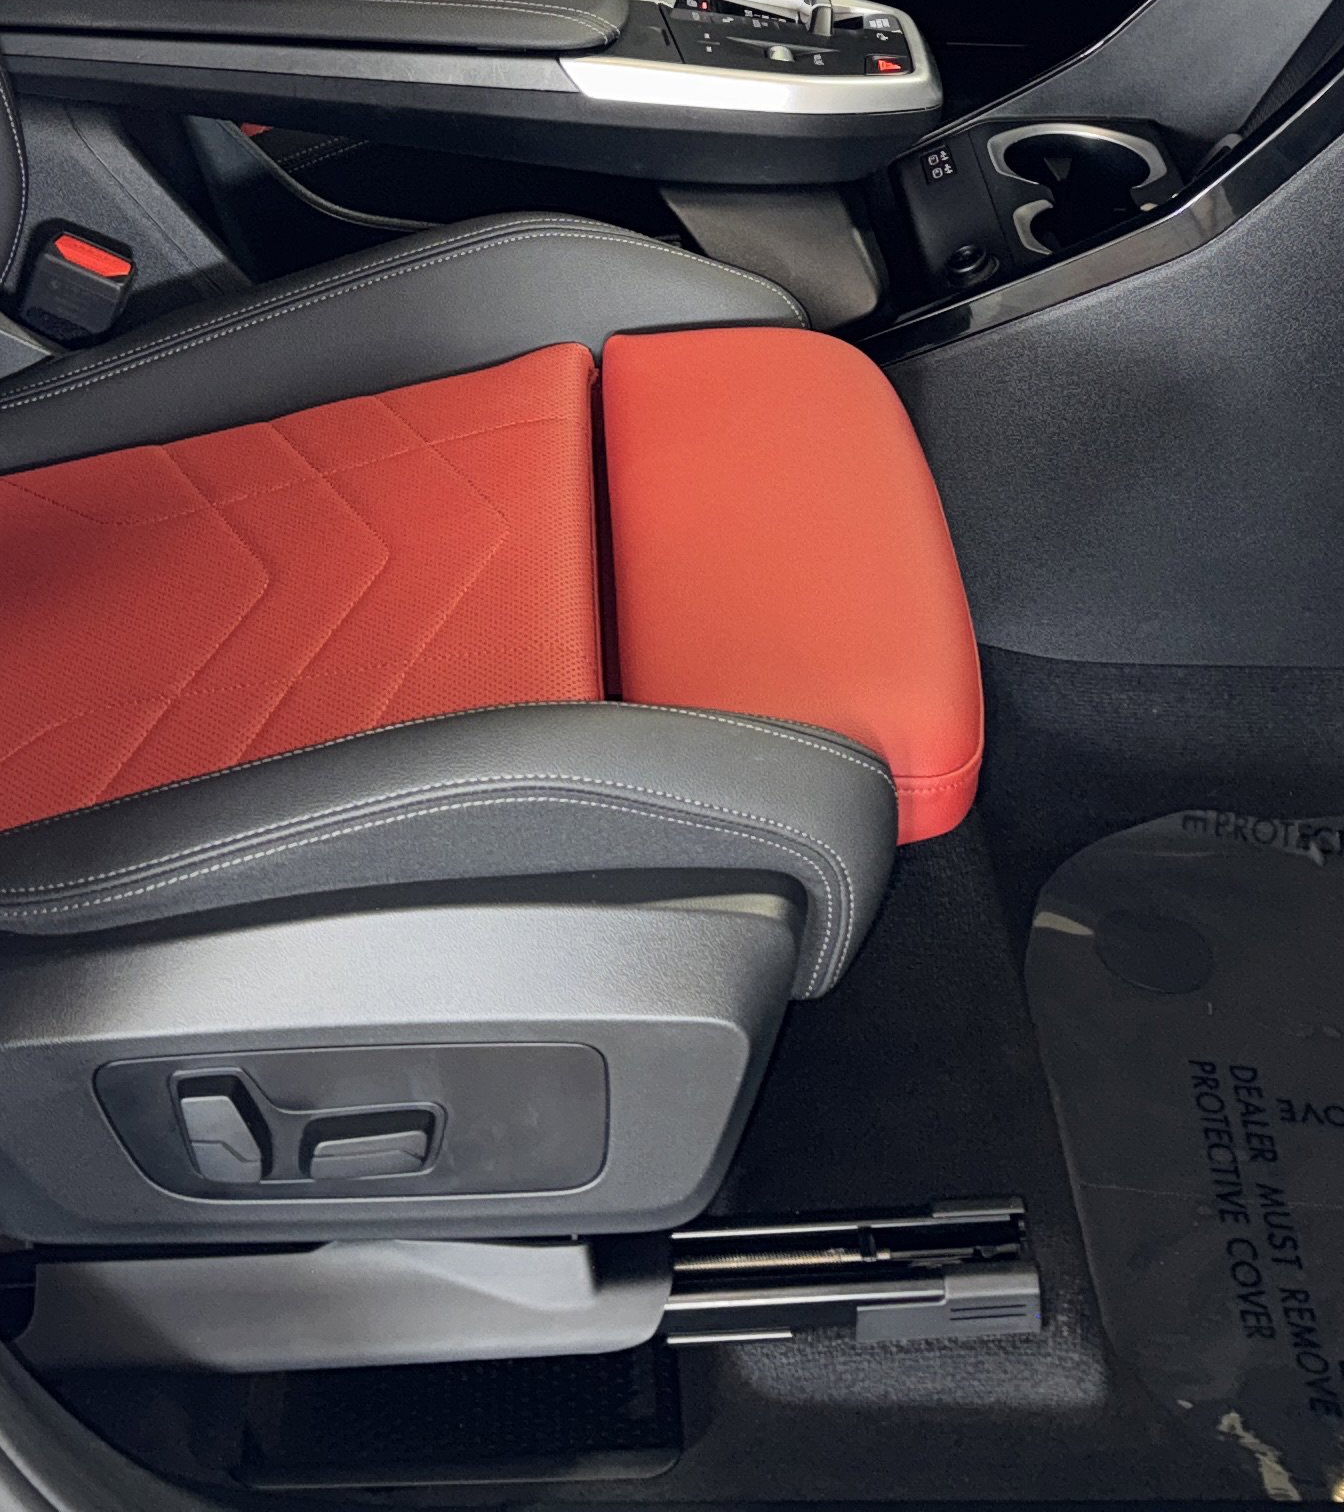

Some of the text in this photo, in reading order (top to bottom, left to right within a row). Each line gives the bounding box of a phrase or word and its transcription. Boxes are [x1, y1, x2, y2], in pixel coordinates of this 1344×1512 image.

[1188, 1059, 1277, 1340] PROTECTIVE COVER
[1229, 1064, 1344, 1419] DEALER MUST REMOVE
